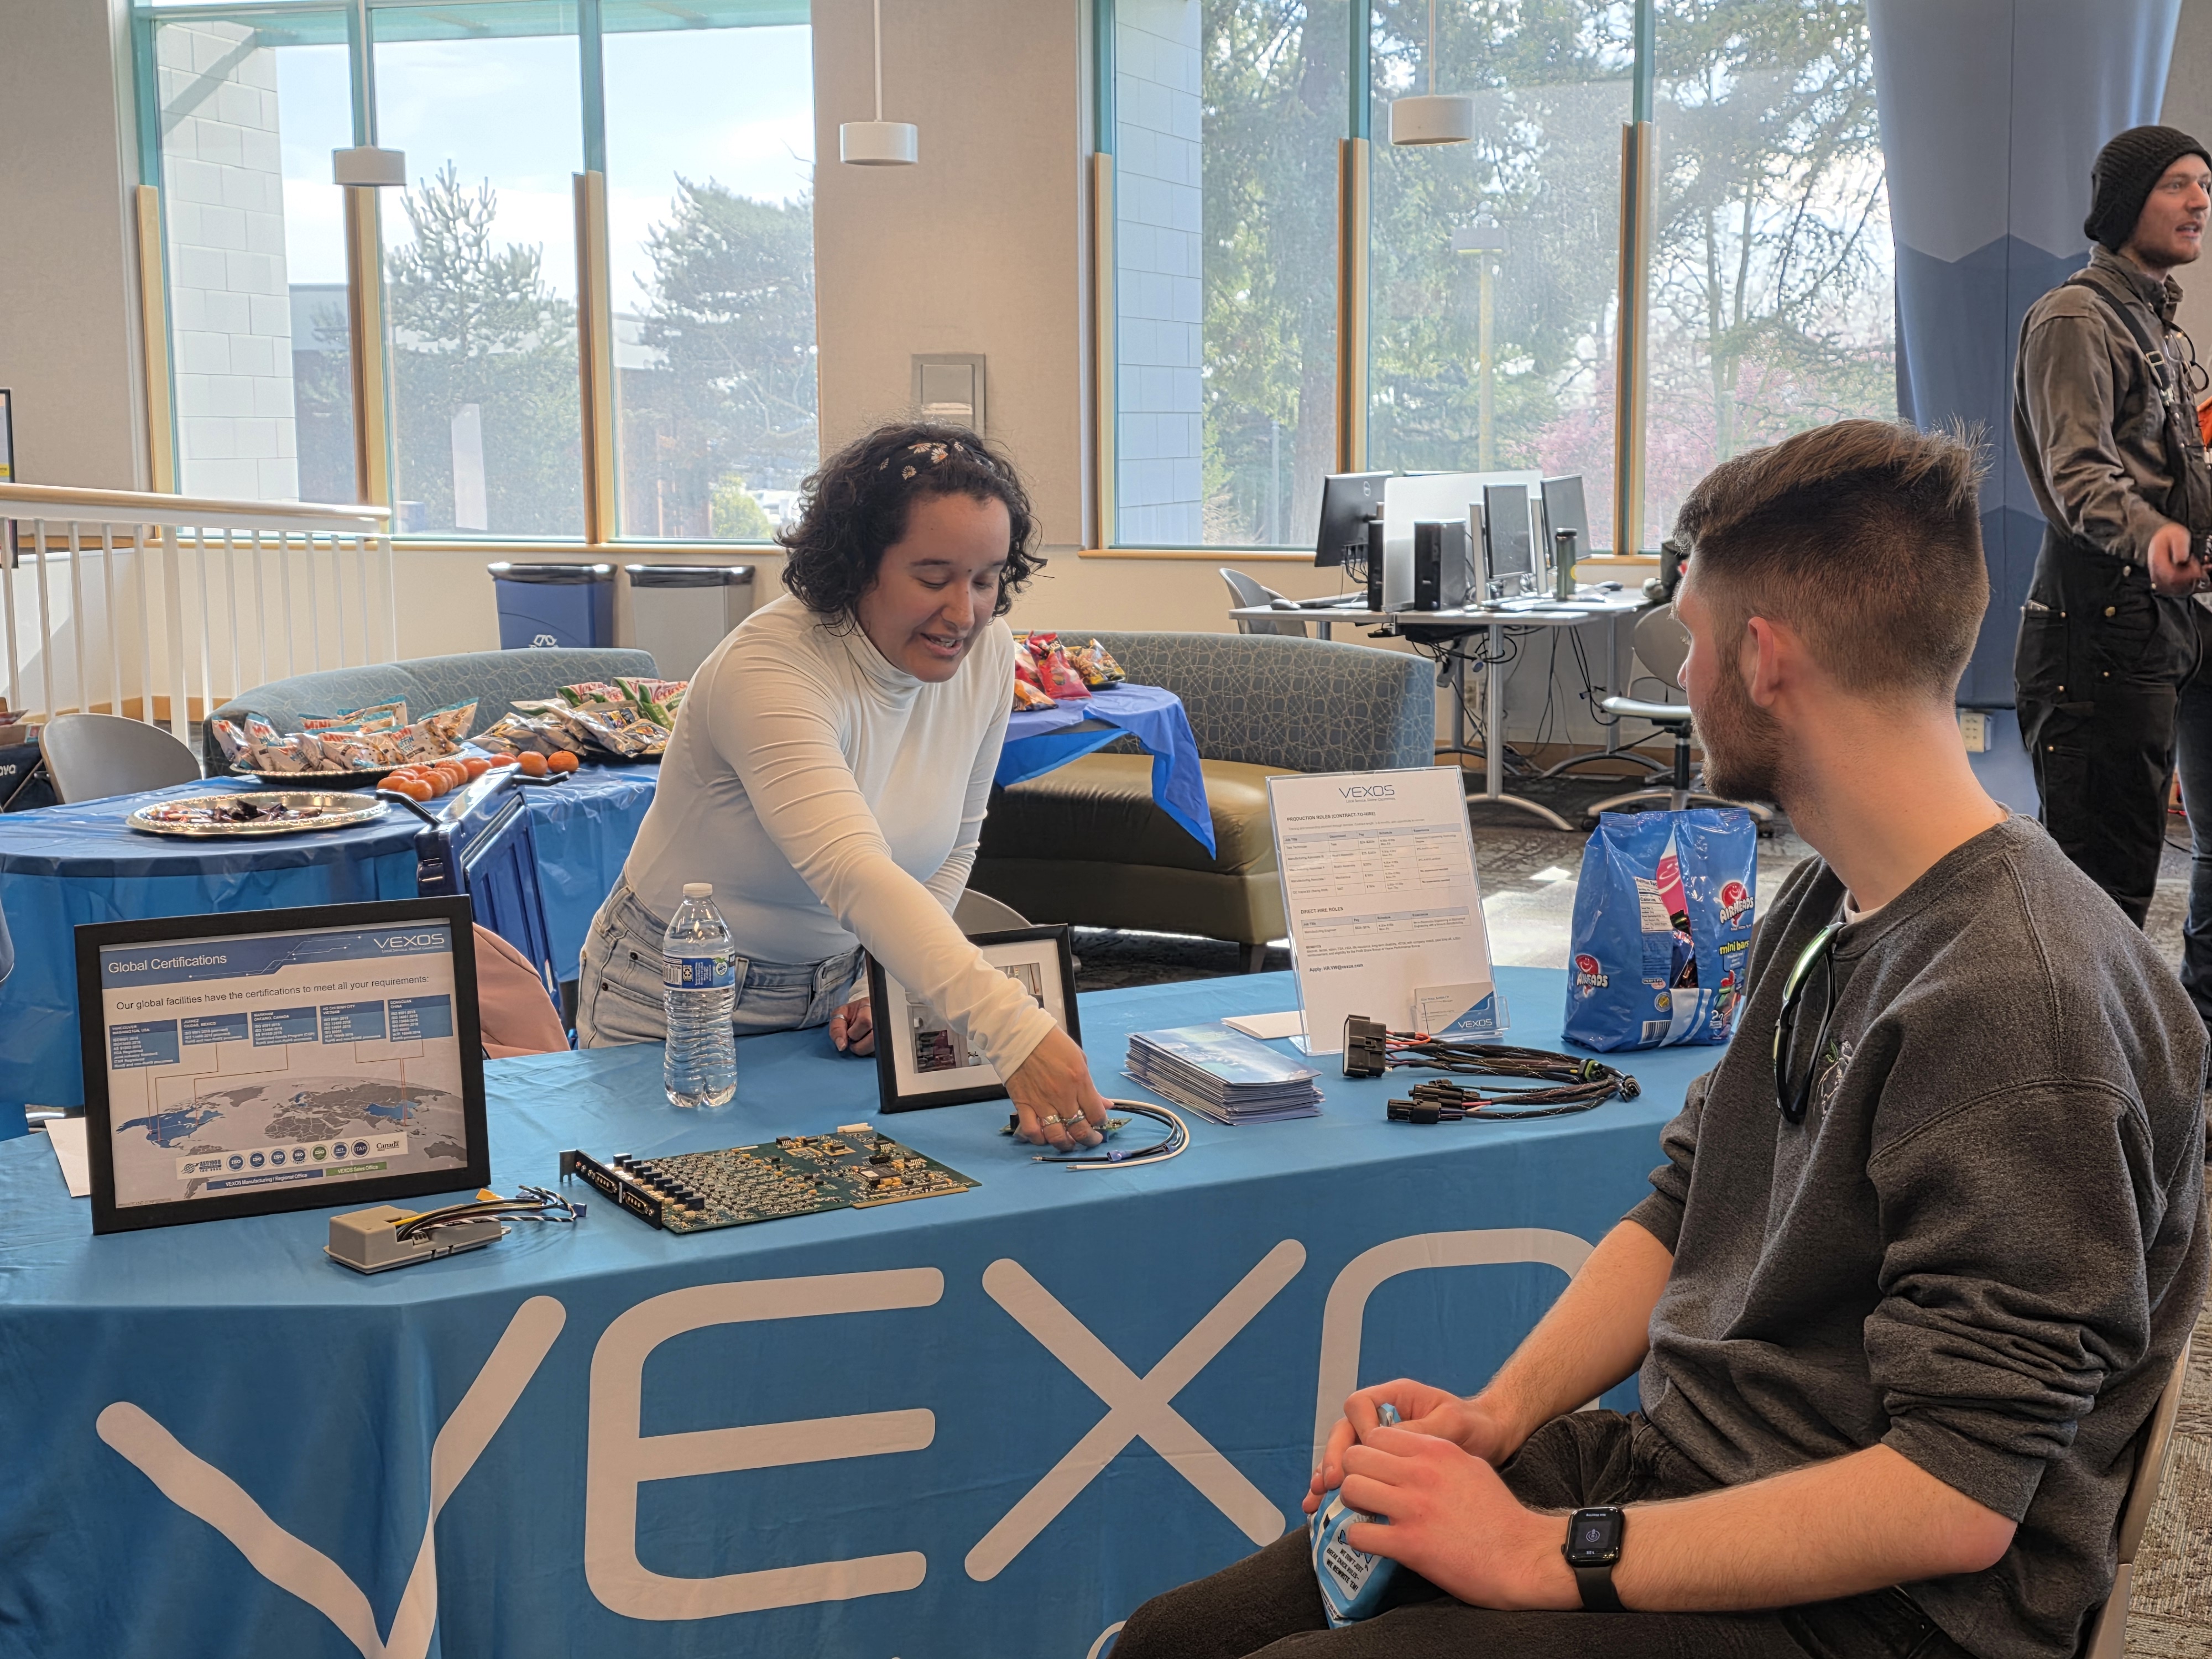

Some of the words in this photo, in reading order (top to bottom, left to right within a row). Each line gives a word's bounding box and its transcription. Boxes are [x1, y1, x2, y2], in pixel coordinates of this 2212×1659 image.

[304, 721, 331, 730] MINI
[1339, 785, 1395, 799] VEXOS
[1719, 896, 1754, 925] AIRHEADS
[373, 933, 445, 948] VEXOS
[1719, 941, 1736, 955] mini
[1736, 940, 1749, 951] bars
[108, 959, 148, 973] Global
[150, 954, 227, 970] Certifications
[116, 1001, 134, 1010] Our
[136, 998, 164, 1010] global
[166, 995, 202, 1006] facilities
[205, 994, 227, 1003] have
[246, 986, 300, 998] certifications
[314, 984, 336, 992] meet
[337, 982, 347, 990] all
[350, 981, 369, 991] your
[372, 975, 429, 988] requirements:
[1458, 1019, 1493, 1029] VEXOS
[1326, 1547, 1338, 1561] BREAK
[1337, 1557, 1348, 1569] SNACK
[1339, 1548, 1346, 1556] WE
[1345, 1553, 1355, 1564] DON'T
[1355, 1562, 1364, 1573] JUST
[1326, 1558, 1333, 1569] WE
[1333, 1564, 1350, 1584] REWRITE
[1350, 1579, 1359, 1592] 'EM!
